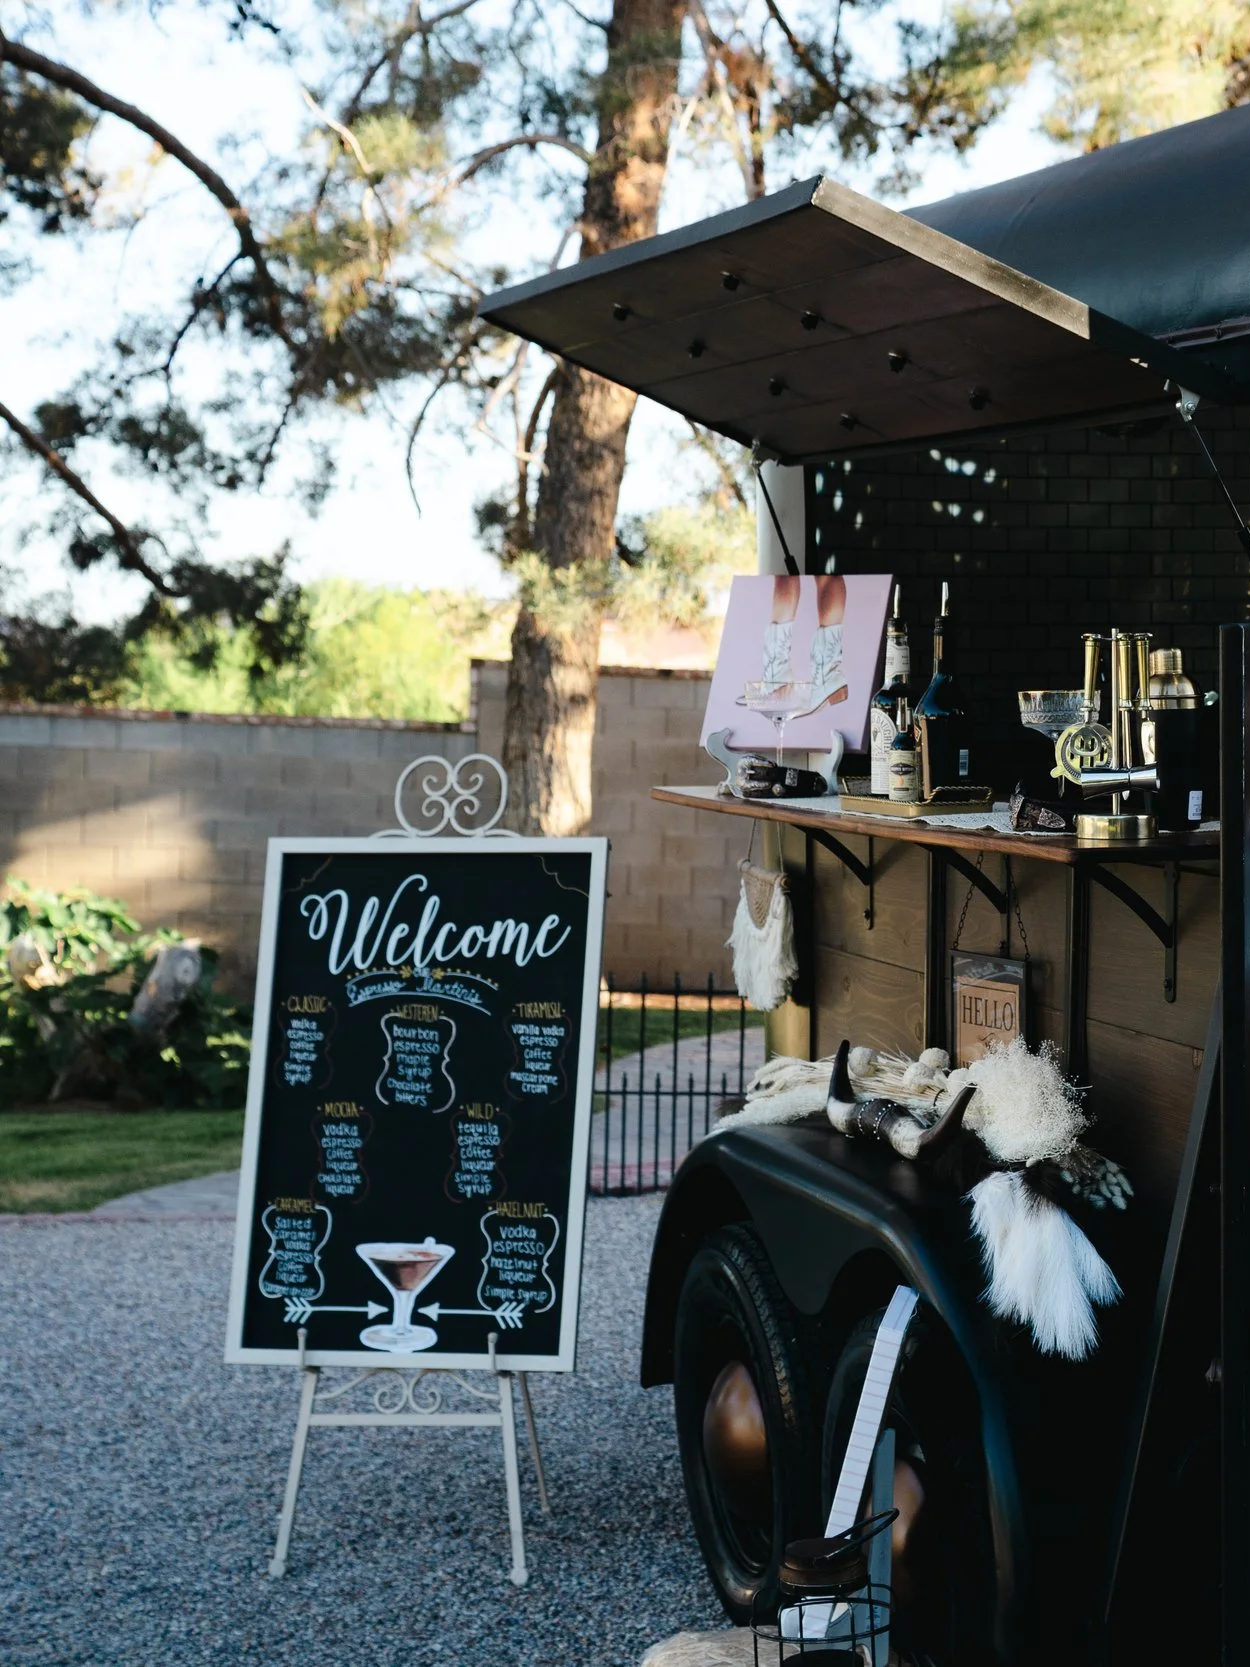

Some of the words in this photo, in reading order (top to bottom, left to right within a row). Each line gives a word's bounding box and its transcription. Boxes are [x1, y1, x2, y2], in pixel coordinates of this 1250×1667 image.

[300, 874, 572, 975] Welcome
[962, 995, 1014, 1031] HELLO
[393, 1040, 440, 1054] espresso
[520, 1035, 559, 1047] espresso
[324, 1102, 359, 1118] MOCHA
[466, 1103, 494, 1120] WILD
[457, 1121, 499, 1137] tequila
[321, 1137, 362, 1149] espresso
[492, 1240, 546, 1255] espresso
